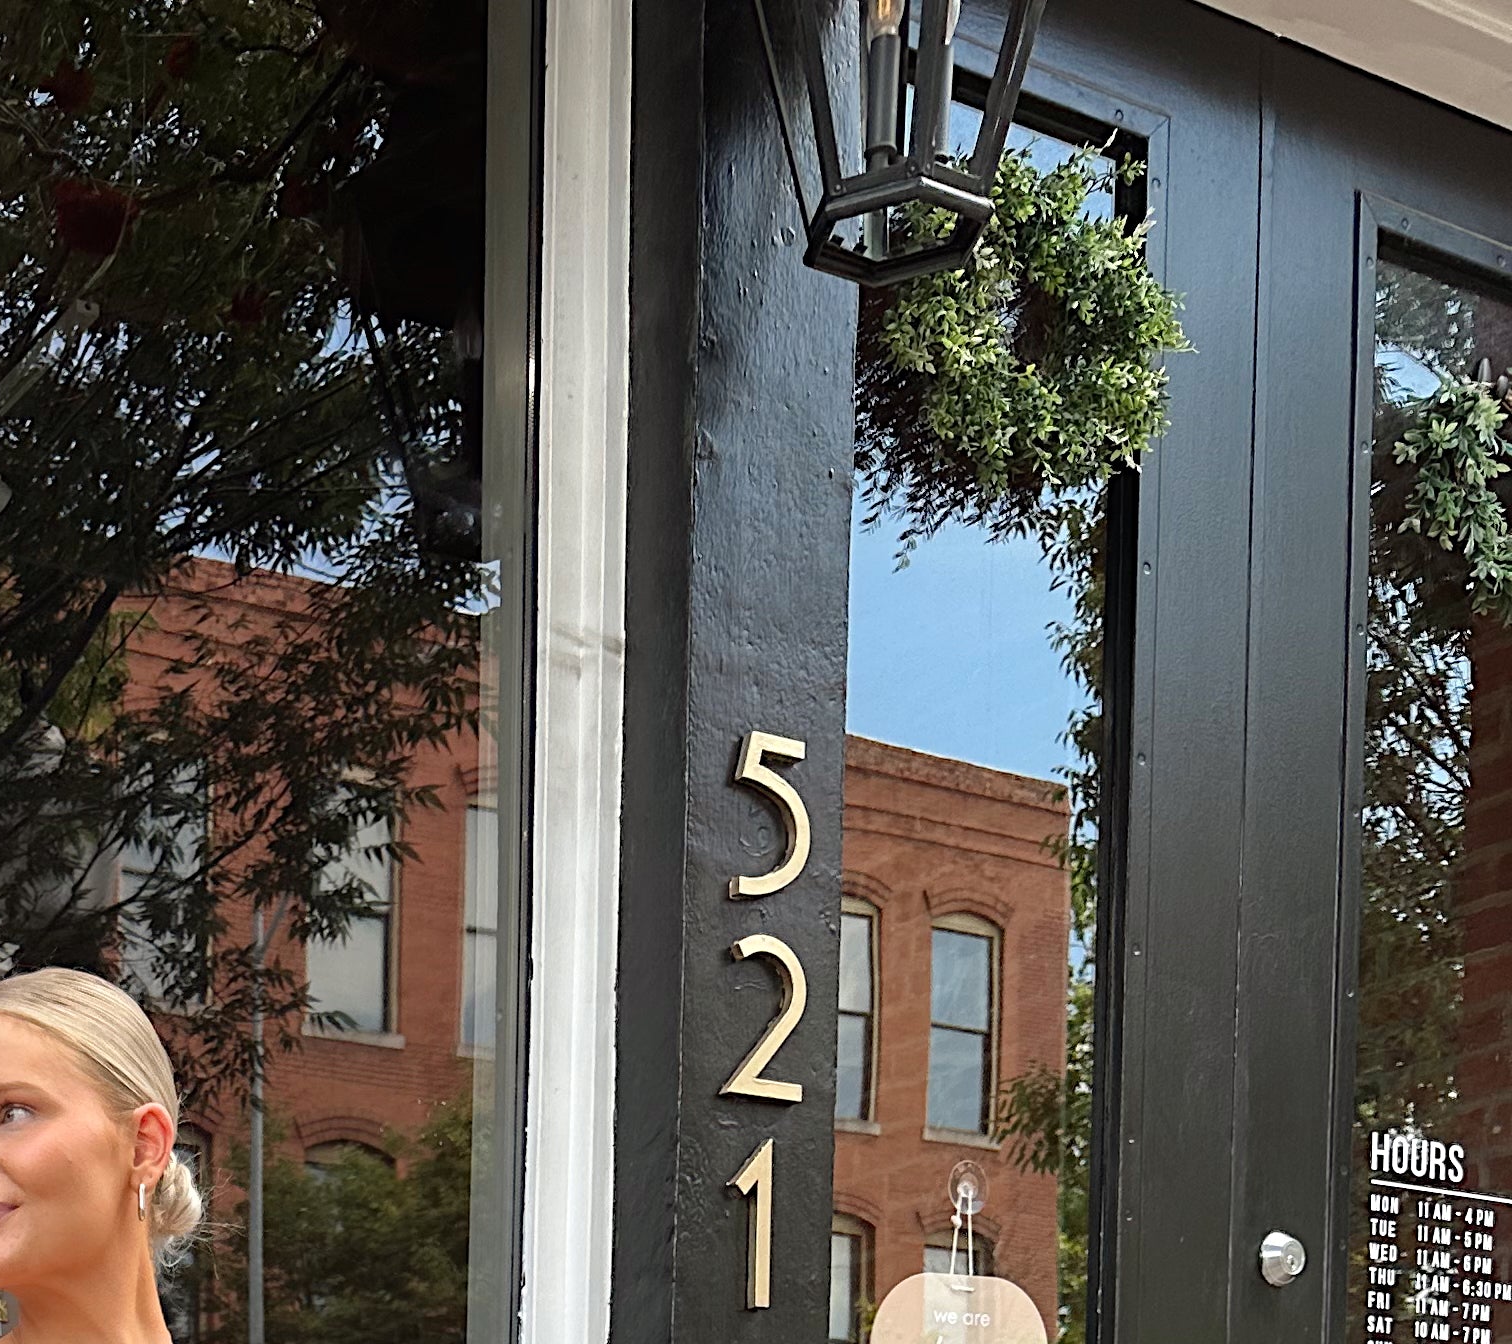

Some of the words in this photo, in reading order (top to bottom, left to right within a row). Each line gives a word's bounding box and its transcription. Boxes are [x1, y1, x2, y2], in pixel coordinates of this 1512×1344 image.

[719, 730, 812, 1310] 521
[1371, 1132, 1464, 1182] HOURS
[1371, 1194, 1398, 1214] MON
[1418, 1201, 1429, 1218] 11
[1433, 1204, 1451, 1221] AM
[1465, 1208, 1472, 1224] 4
[1477, 1209, 1493, 1226] PM
[1371, 1218, 1396, 1237] TUE
[1418, 1225, 1429, 1242] 11
[1433, 1227, 1450, 1245] AM
[1464, 1232, 1472, 1247] 5
[1475, 1233, 1492, 1250] PM
[1370, 1243, 1397, 1261] WED
[1417, 1249, 1428, 1265] 11
[1432, 1251, 1450, 1268] AM
[1463, 1256, 1471, 1271] 6
[1474, 1257, 1491, 1274] PM
[1369, 1267, 1395, 1285] THU
[1415, 1273, 1426, 1289] 11
[1432, 1276, 1449, 1292] AM
[1463, 1280, 1491, 1298] 6:30
[1495, 1283, 1511, 1300] PM
[934, 1310, 958, 1325] we
[962, 1313, 991, 1327] are
[1368, 1291, 1390, 1309] FRI
[1415, 1298, 1426, 1314] 11
[1430, 1299, 1448, 1316] AM
[1462, 1303, 1469, 1319] 7
[1472, 1304, 1489, 1321] PM
[1367, 1315, 1392, 1334] SAT
[1414, 1321, 1427, 1338] 10
[1431, 1322, 1449, 1340] AM
[1462, 1327, 1469, 1343] 7
[1472, 1328, 1490, 1344] PM
